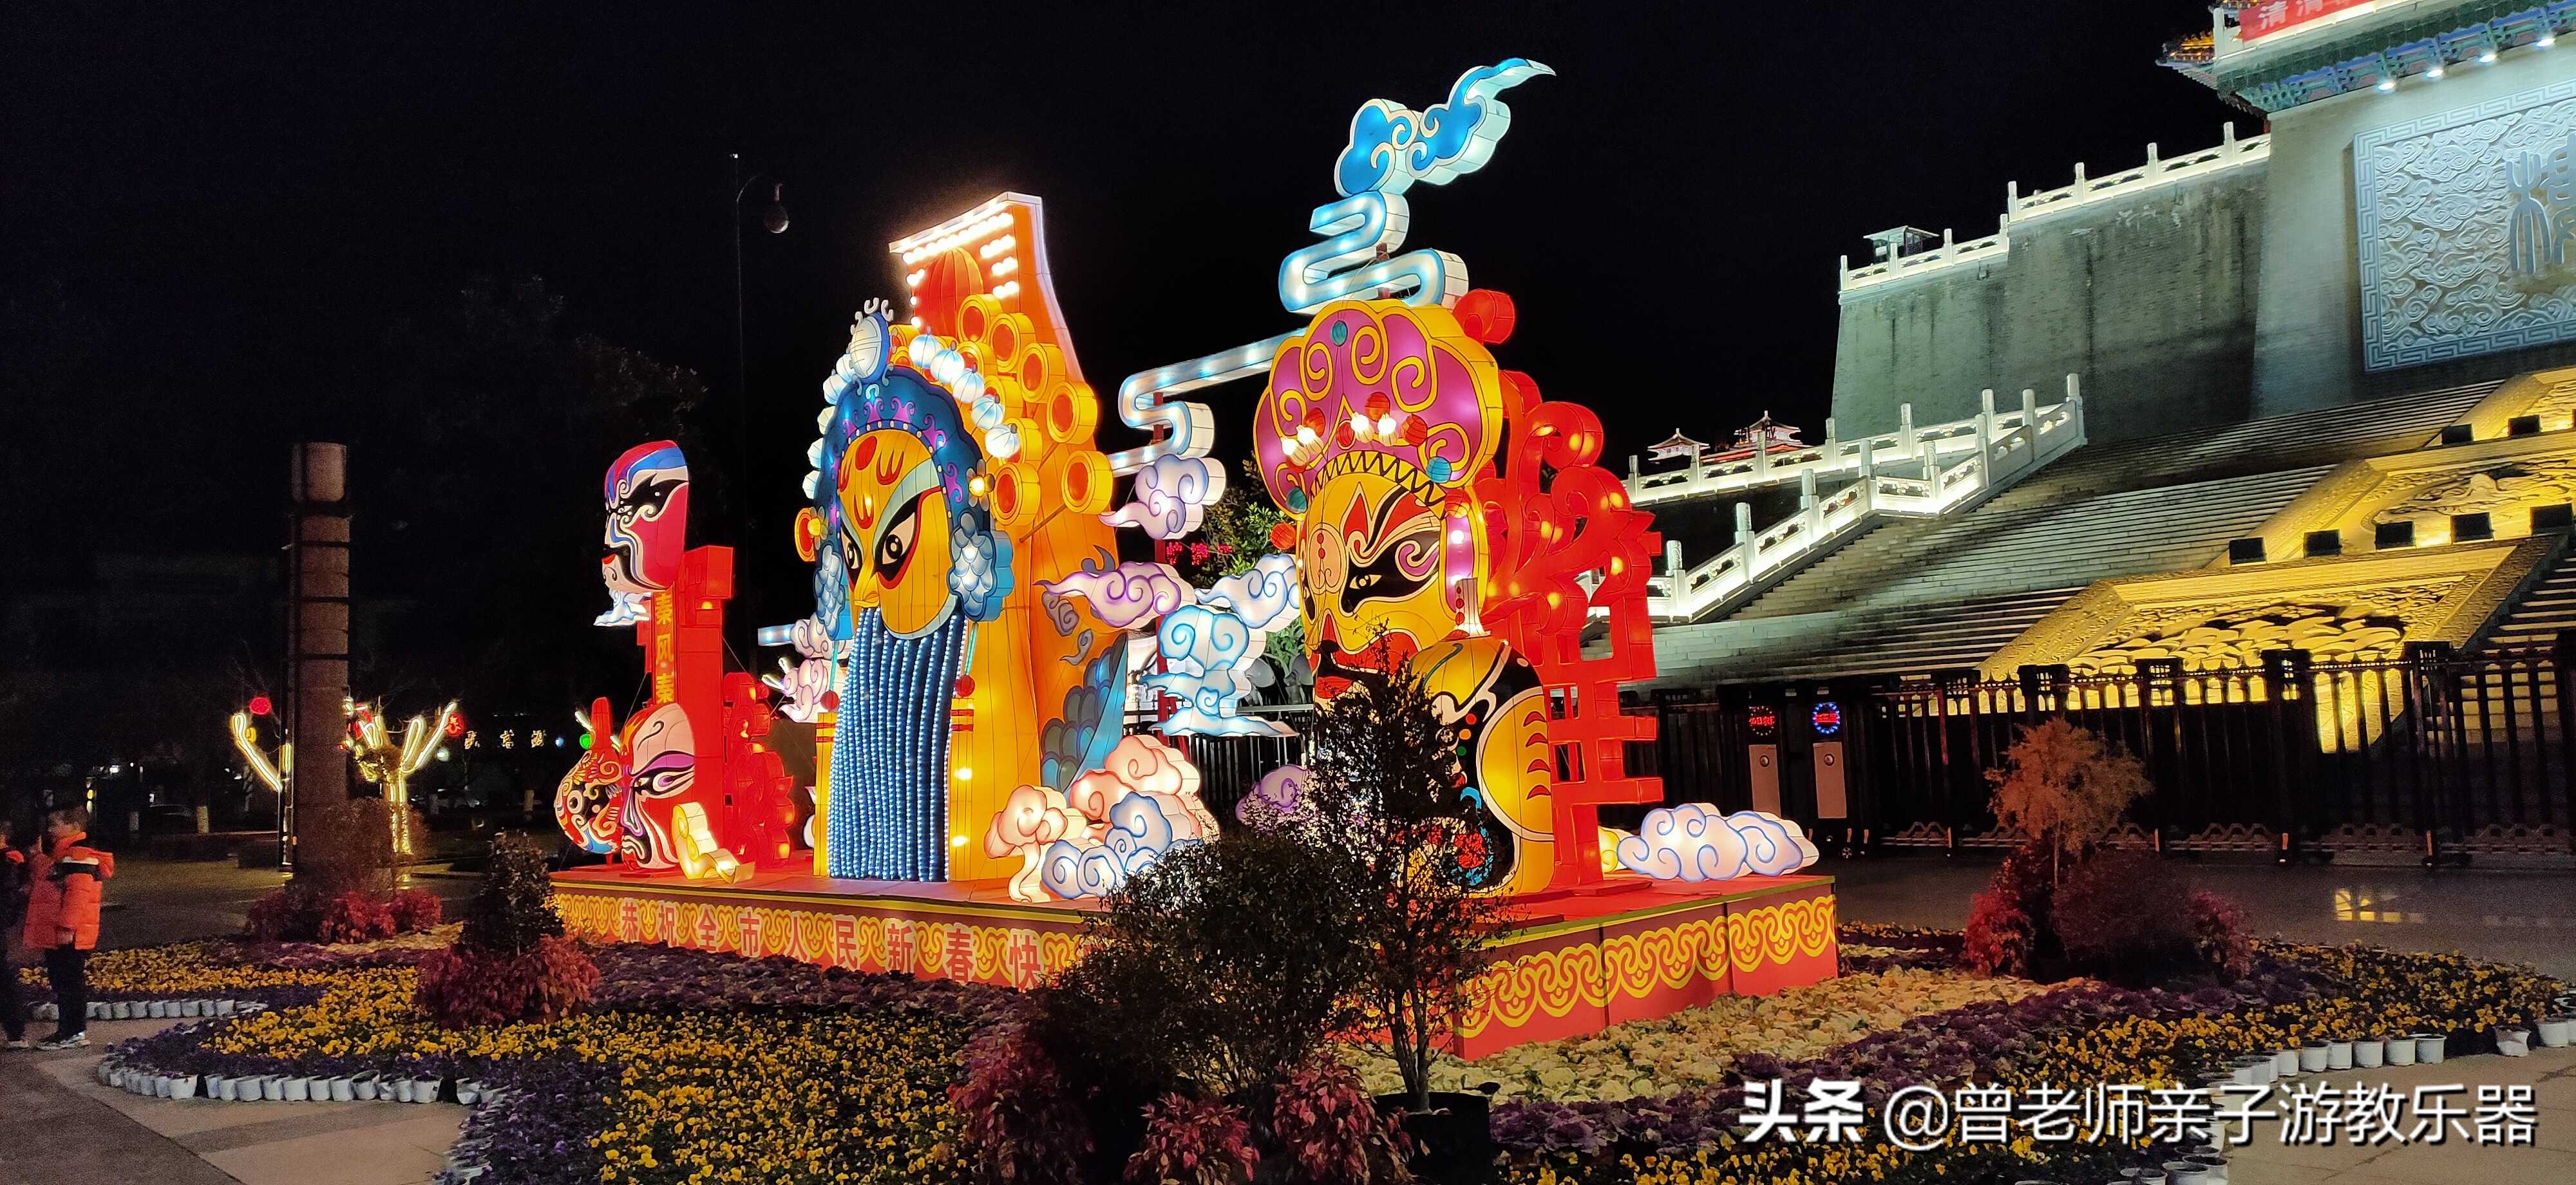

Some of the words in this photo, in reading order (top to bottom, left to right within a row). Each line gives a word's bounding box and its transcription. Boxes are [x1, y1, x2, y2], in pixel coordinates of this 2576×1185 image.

[621, 898, 1109, 991] 恭祝全市人民新春快
